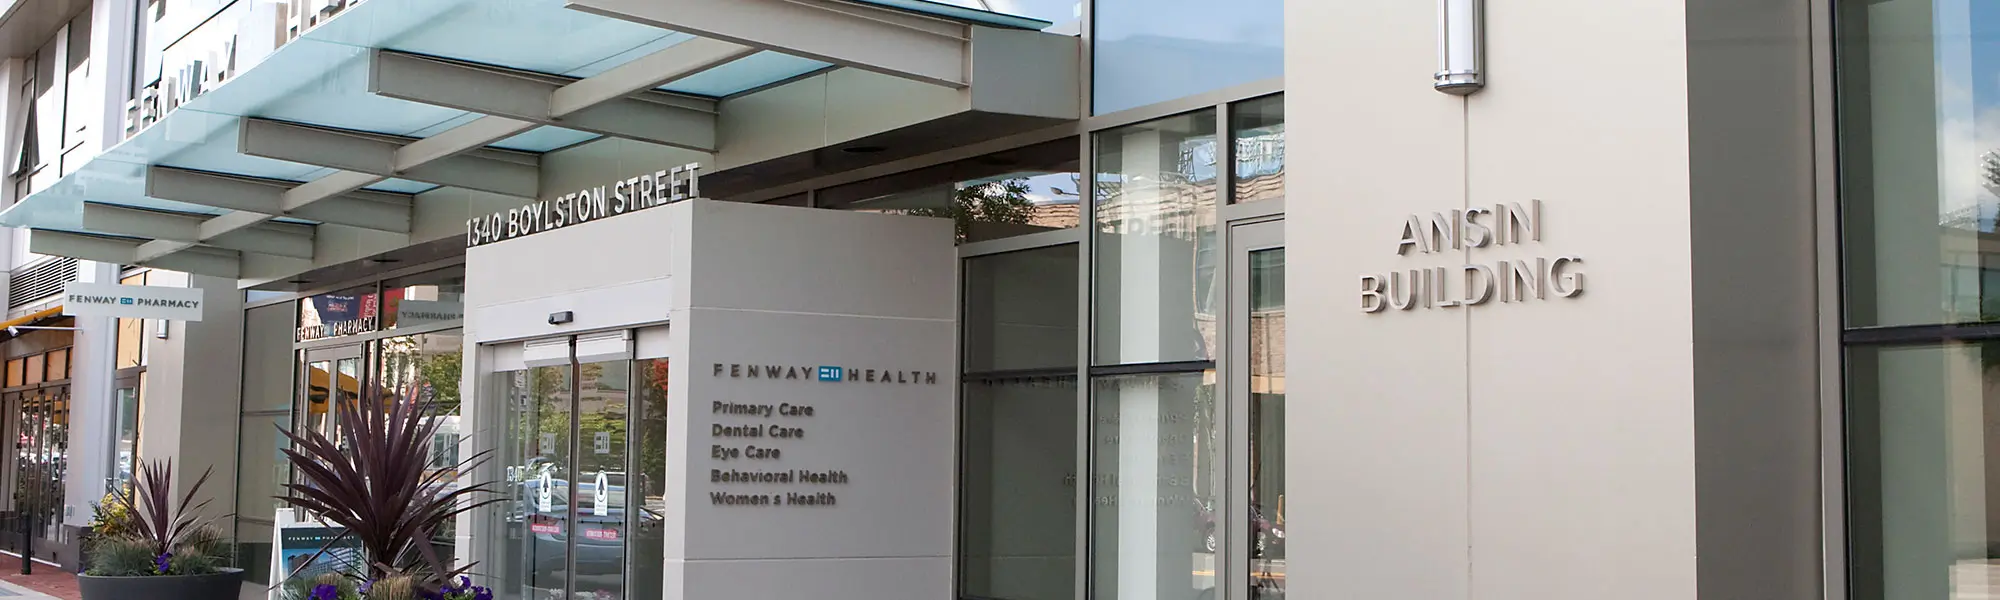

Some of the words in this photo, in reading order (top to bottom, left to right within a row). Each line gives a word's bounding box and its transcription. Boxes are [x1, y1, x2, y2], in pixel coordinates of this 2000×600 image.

[466, 212, 502, 247] 1340
[508, 185, 607, 238] BOYLSTON
[614, 162, 701, 214] STREET
[1397, 199, 1541, 256] ANSIN
[1360, 257, 1584, 314] BUILDING
[69, 295, 116, 304] FENWAY
[137, 298, 199, 309] PHARMACY
[297, 323, 325, 340] FENWAY
[333, 315, 374, 336] PHARMACY
[713, 363, 812, 380] FENWAY
[848, 368, 937, 385] HEALTH
[712, 400, 773, 418] Primary
[778, 403, 814, 416] Care
[711, 424, 763, 438] Dental
[768, 425, 804, 438] Care
[711, 445, 739, 461] Eye
[745, 446, 781, 460] Care
[710, 469, 793, 483] Behavioral
[799, 470, 848, 484] Health
[710, 492, 782, 506] Womens
[786, 492, 836, 506] Health
